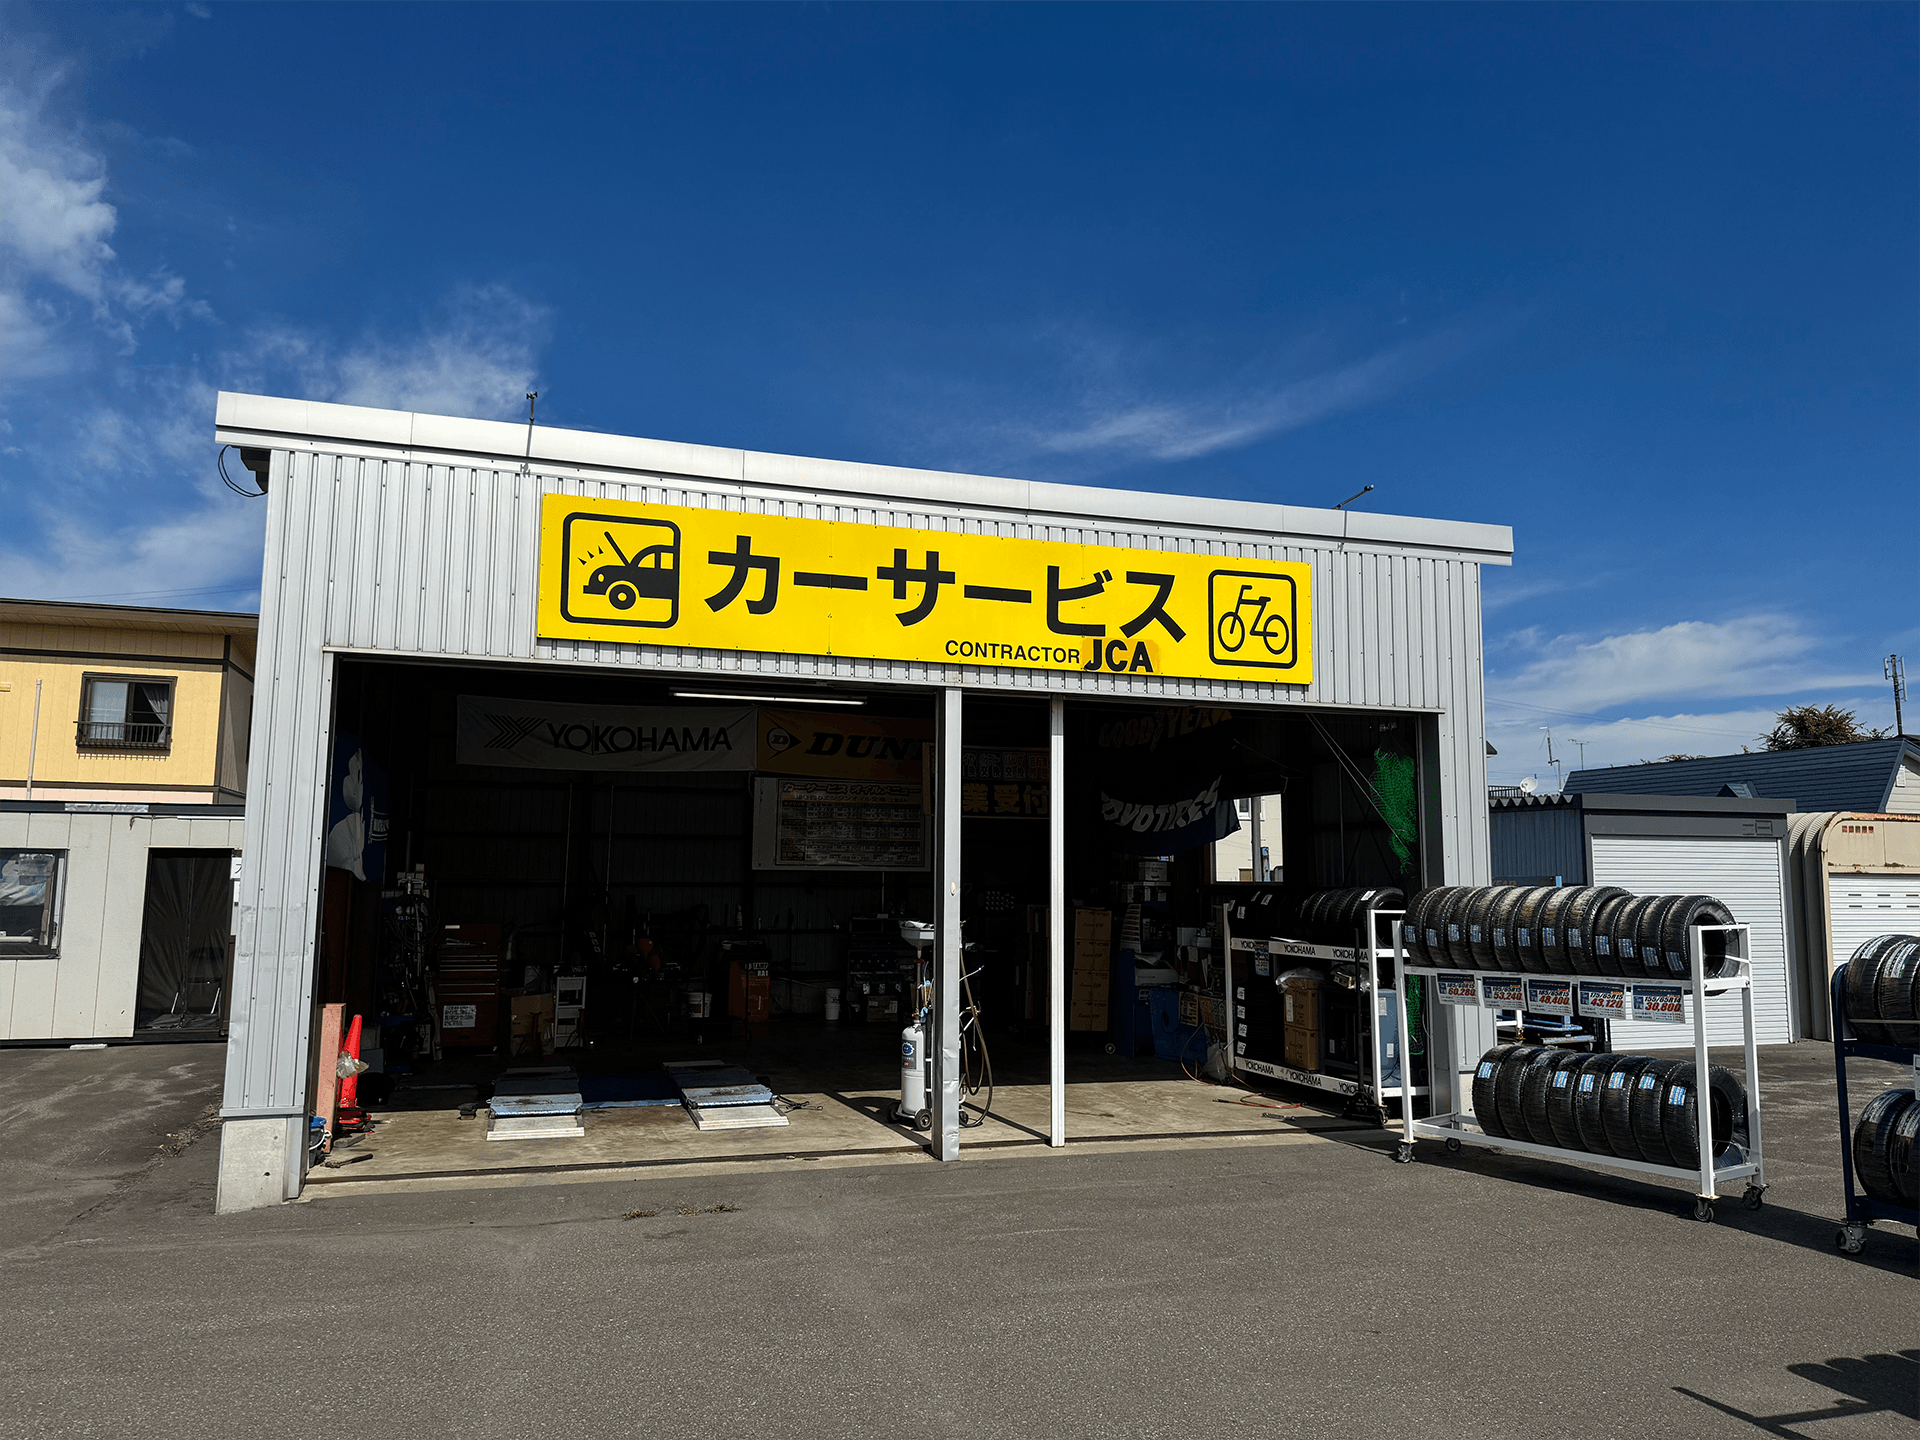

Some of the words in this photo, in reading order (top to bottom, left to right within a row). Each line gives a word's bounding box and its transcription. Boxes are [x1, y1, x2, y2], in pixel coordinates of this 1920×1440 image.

[705, 534, 1186, 644] カーサービス
[945, 639, 1080, 663] CONTRACTOR
[1084, 637, 1154, 673] JCA
[546, 722, 733, 752] YOKOHAMA
[783, 782, 848, 794] カーサービス
[850, 785, 922, 796] オイルメニュー
[1283, 944, 1316, 956] YOKOHAMA
[1332, 948, 1368, 961] YOKOHMA
[1448, 987, 1476, 996] 60,280
[1493, 991, 1522, 1001] 53,240
[1539, 995, 1570, 1005] 48,400
[1590, 998, 1623, 1009] 43,120
[1645, 1002, 1682, 1012] 30,800
[1244, 1060, 1274, 1076] YOKOHAMA
[1289, 1071, 1322, 1087] YOKOHAMA
